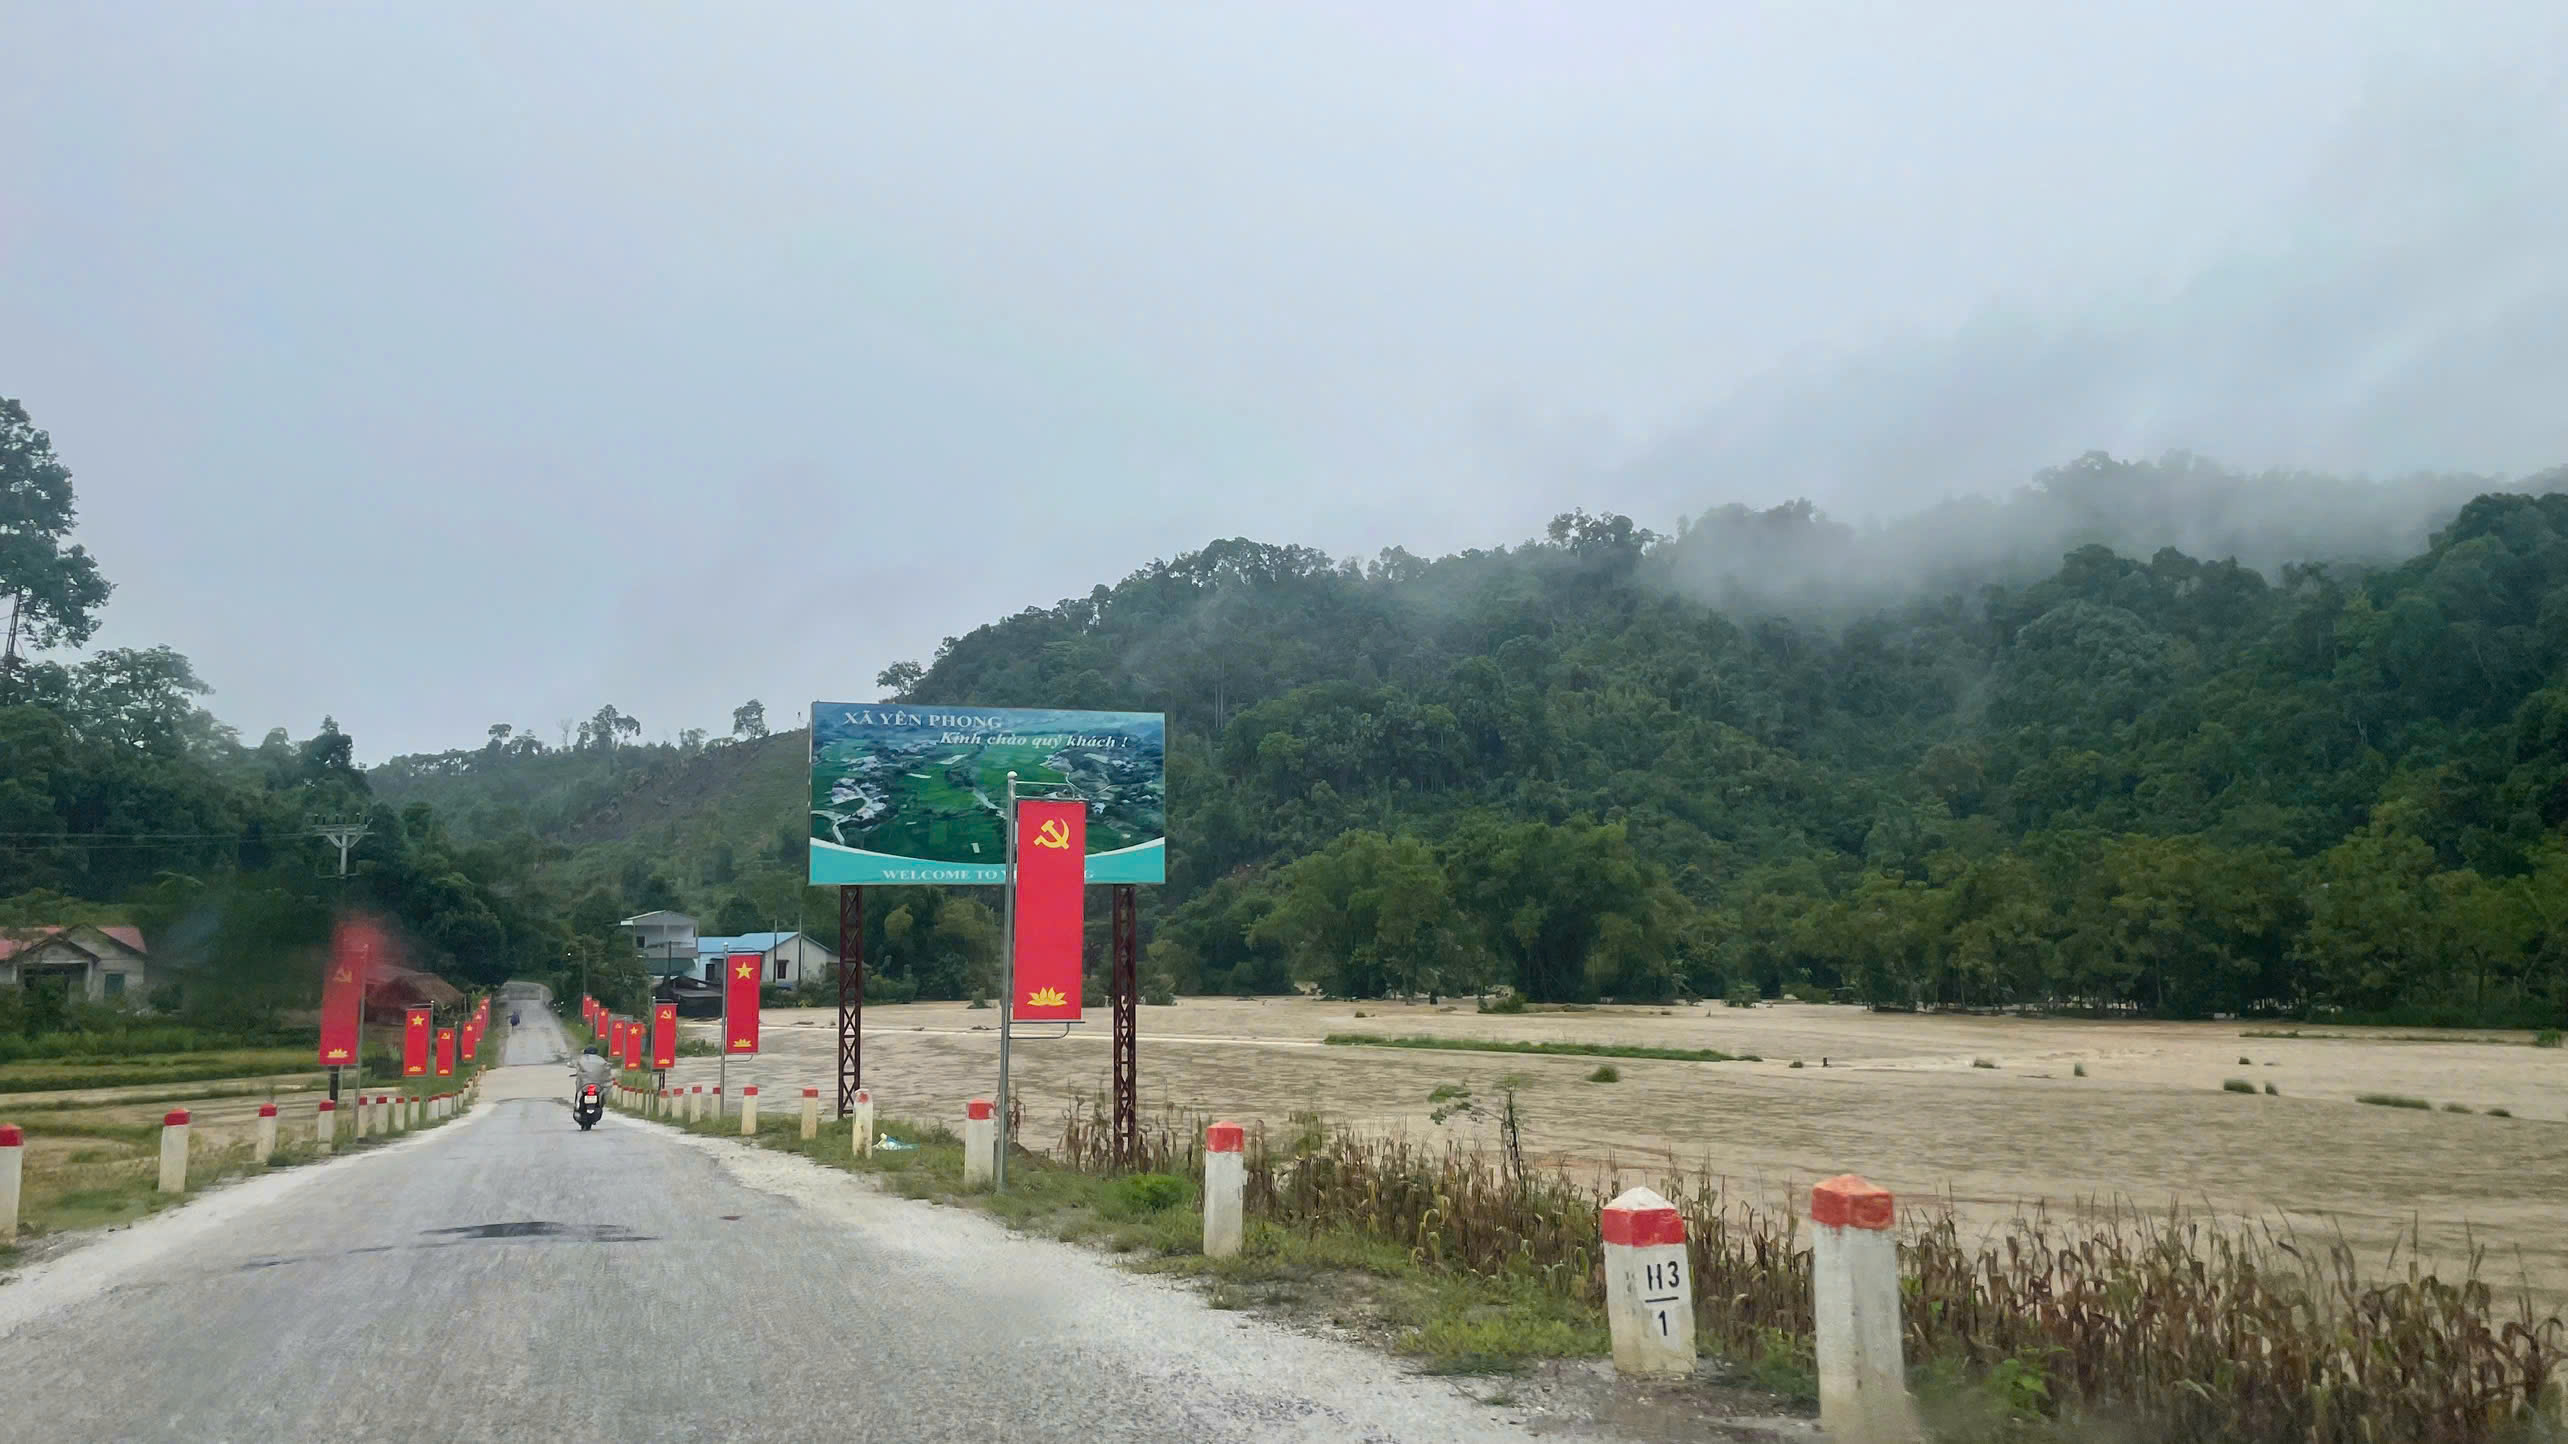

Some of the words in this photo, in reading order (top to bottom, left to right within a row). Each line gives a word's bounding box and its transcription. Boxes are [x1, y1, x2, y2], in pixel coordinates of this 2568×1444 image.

[843, 710, 873, 725] XÃ
[880, 710, 922, 726] YÊN
[929, 714, 1002, 729] PHONG
[987, 733, 1027, 746] chào
[1032, 735, 1062, 749] quý
[1066, 735, 1116, 748] khách
[882, 870, 971, 880] WELCOME
[976, 870, 998, 880] TO
[1647, 1261, 1680, 1291] H3
[1658, 1310, 1668, 1336] 1
